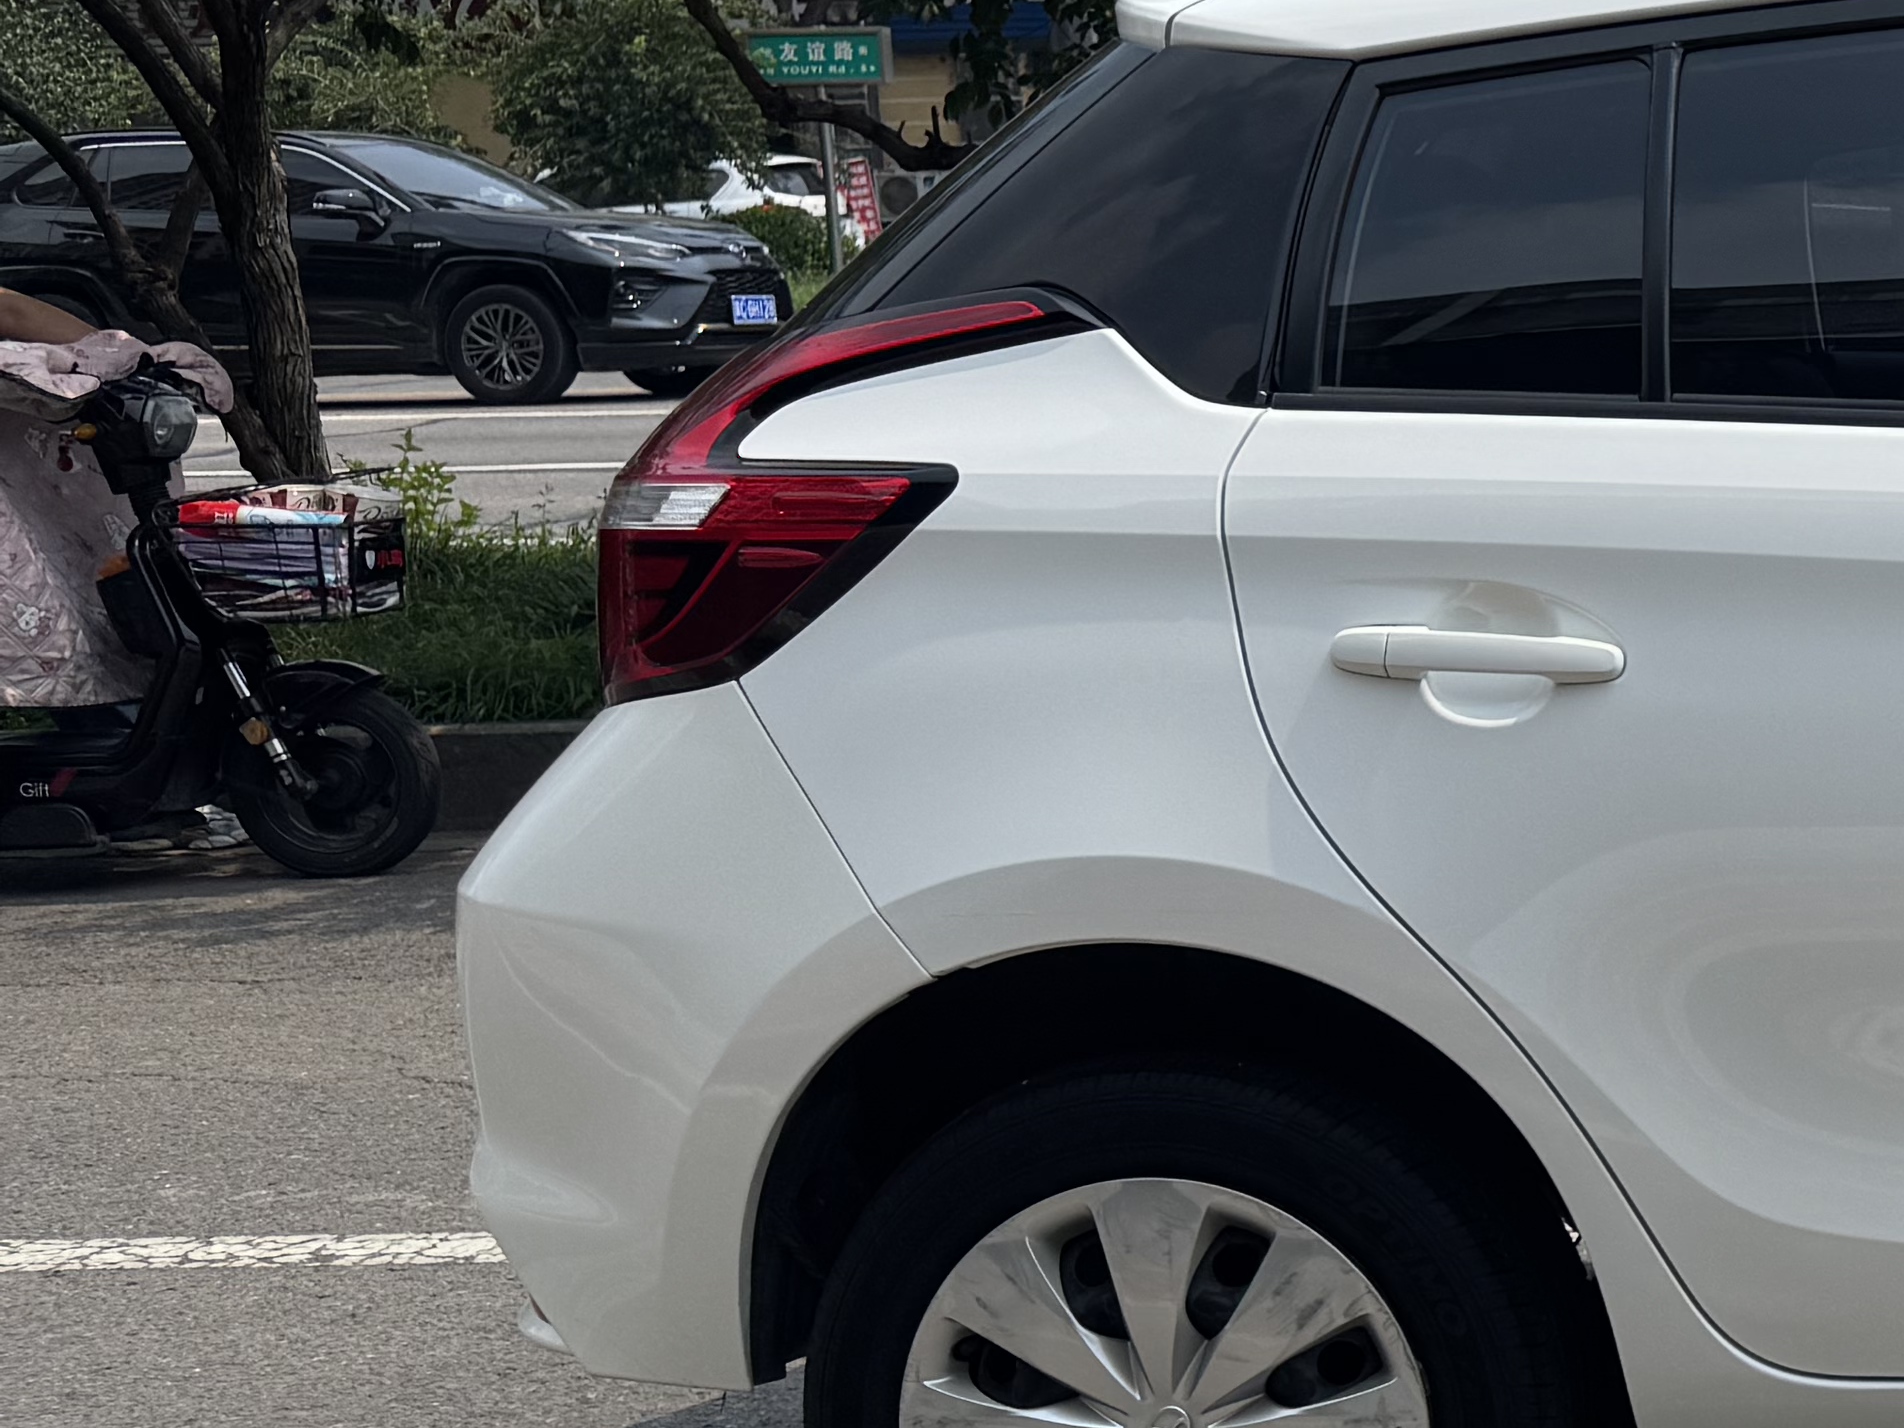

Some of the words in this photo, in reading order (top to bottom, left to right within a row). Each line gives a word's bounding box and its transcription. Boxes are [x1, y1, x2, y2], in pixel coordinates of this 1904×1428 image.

[779, 40, 853, 62] 友谊路
[782, 64, 823, 75] YOUYI
